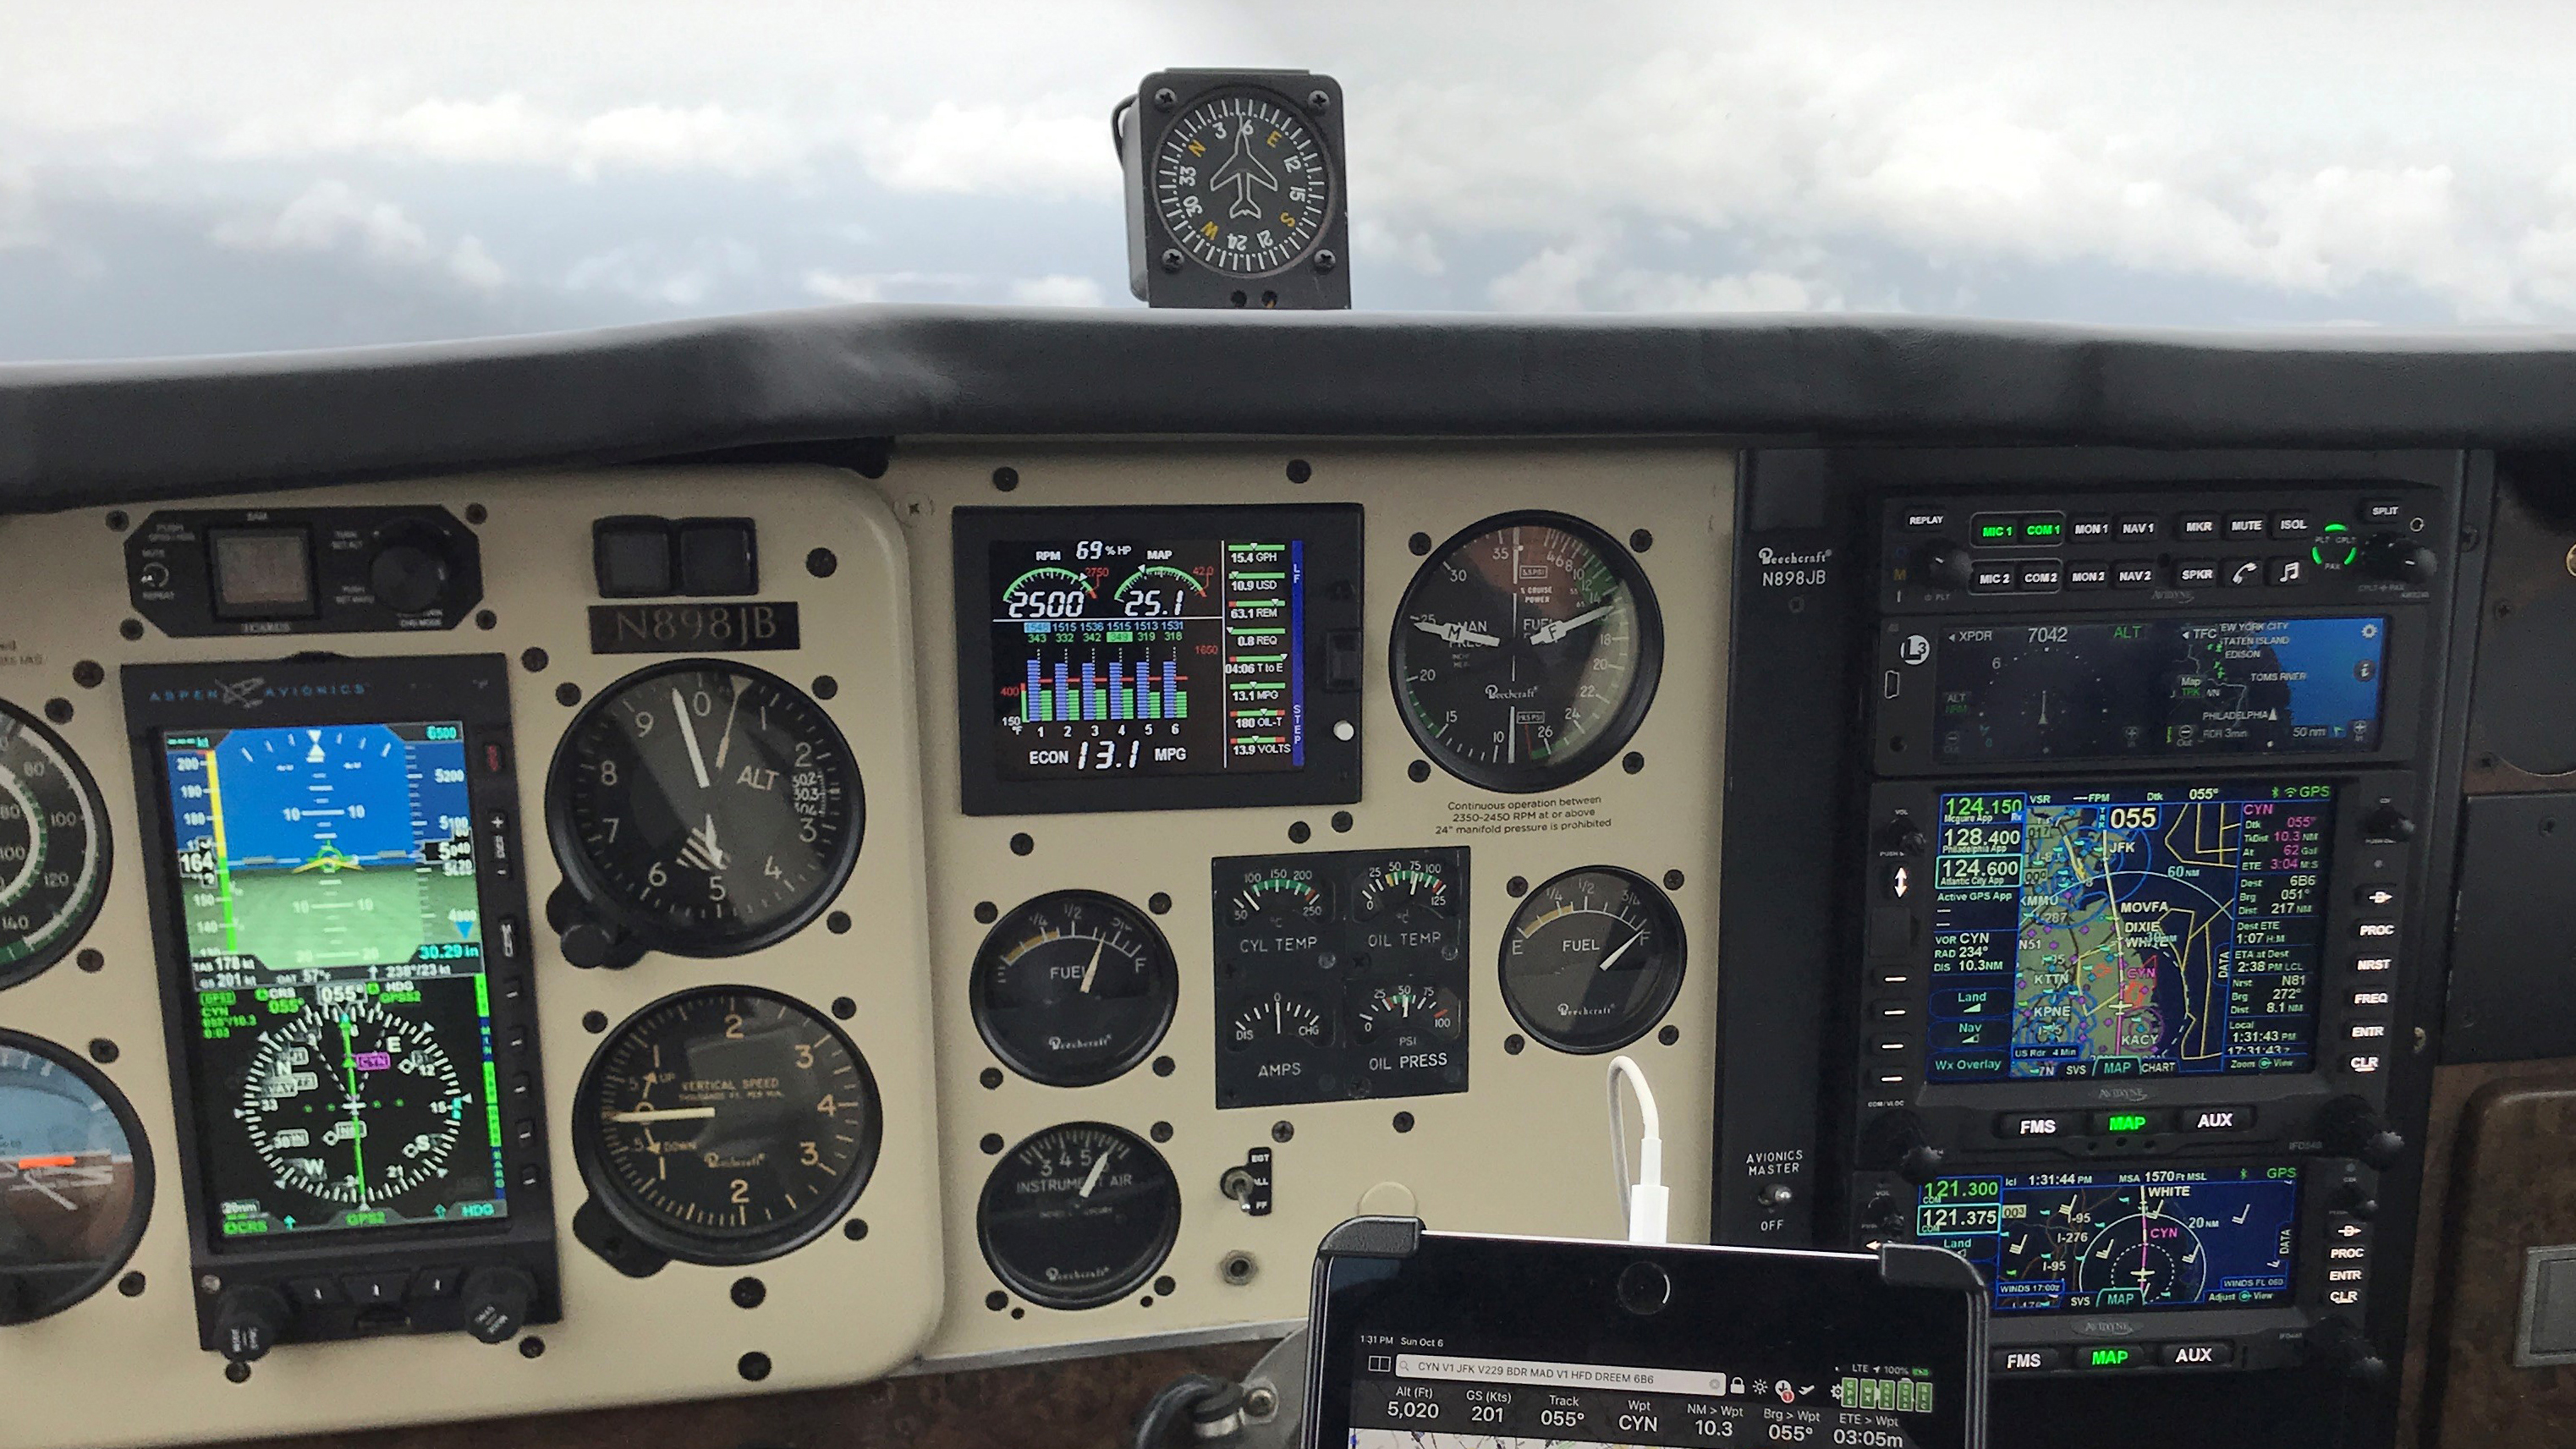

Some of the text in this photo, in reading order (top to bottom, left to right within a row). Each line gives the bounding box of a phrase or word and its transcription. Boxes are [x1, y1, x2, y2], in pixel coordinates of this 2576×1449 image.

[1211, 122, 1228, 140] 3
[1266, 130, 1283, 149] E
[1187, 139, 1207, 158] N
[1283, 155, 1302, 174] 12
[1178, 165, 1197, 187] 33
[1289, 185, 1306, 203] 15
[1279, 211, 1296, 228] S
[2372, 506, 2399, 516] SPLIT
[1909, 515, 1944, 525] REPLAY
[2186, 520, 2212, 533] MKR
[2231, 520, 2264, 531] MUTE
[2280, 519, 2307, 530] ISOL
[1981, 526, 2013, 537] MIC 1
[2026, 524, 2060, 535] COM 1
[2074, 524, 2108, 535] MON 1
[2123, 523, 2155, 534] NAV 1
[1035, 551, 1062, 561] RPM
[1146, 550, 1173, 560] MAP
[1230, 552, 1277, 563] 15.4 GPH
[1491, 546, 1510, 561] 35
[1757, 546, 1827, 565] Beechcraft
[1449, 568, 1468, 582] 30
[1761, 569, 1827, 587] N898JB
[2181, 568, 2213, 581] SPKR
[1231, 579, 1277, 591] 10.9 USD
[1008, 591, 1085, 618] 2500
[1124, 590, 1184, 617] 25.1
[1230, 607, 1277, 619] 63.1 REM
[615, 606, 777, 646] N898JB
[2193, 628, 2218, 639] TFC
[1237, 635, 1277, 646] 0.8 REQ
[1958, 625, 2143, 644] XPDR 7042 ALT
[2223, 650, 2261, 659] EDISON
[1419, 668, 1436, 682] 20
[1484, 683, 1535, 700] Beechcraft
[2202, 711, 2270, 721] PHILADELPHIA
[634, 711, 655, 739] 9
[1536, 725, 1554, 739] 26
[1029, 740, 1187, 771] ECON 13.1 MPG
[1233, 744, 1292, 755] 13.9 VOLTS
[599, 760, 618, 787] 8
[735, 765, 781, 792] ALT
[2299, 786, 2332, 798] GPS
[1447, 795, 1602, 811] Continuous operation between
[1945, 797, 2023, 816] 124.150
[1452, 809, 1596, 822] 2350-2450 RPM at or above
[2109, 807, 2157, 829] 055
[1455, 824, 1502, 835] manifold
[1503, 823, 1548, 835] pressure
[1550, 822, 1559, 832] is
[1560, 818, 1612, 832] prohibited
[1943, 827, 2021, 847] 128.400
[2109, 842, 2136, 853] JFK
[180, 853, 214, 874] 164
[1942, 859, 2019, 877] 124.600
[2288, 875, 2317, 886] 6B6
[707, 875, 727, 903] 5
[1936, 892, 2013, 903] Active GPS App
[2120, 901, 2169, 914] MOVFA
[2359, 924, 2396, 936] PROC
[1239, 935, 1318, 953] CYL TEMP
[1367, 931, 1442, 948] OIL TEMP
[1562, 938, 1601, 952] FUEL
[1935, 931, 1990, 945] VOR CYN
[2357, 959, 2392, 970] NRST
[1957, 991, 1988, 1003] Land
[2354, 993, 2389, 1005] FREQ
[2033, 1006, 2071, 1017] KPNE
[724, 1013, 745, 1040] 2
[2351, 1026, 2385, 1038] ENTR
[1368, 1051, 1449, 1072] OIL PRESS
[1935, 1058, 2002, 1072] Wx Overlay
[2103, 1062, 2132, 1074] MAP
[2350, 1057, 2379, 1069] CLR
[1257, 1062, 1303, 1078] AMPS
[679, 1076, 781, 1092] VERTICAL SPEED
[816, 1093, 838, 1118] 4
[2019, 1118, 2057, 1134] FMS
[2108, 1114, 2148, 1131] MAP
[2196, 1111, 2235, 1128] AUX
[1745, 1149, 1804, 1164] AVIONICS
[1748, 1161, 1800, 1177] MASTER
[2266, 1167, 2298, 1178] GPS
[1109, 1173, 1134, 1188] AIR
[1924, 1180, 1999, 1199] 121.300
[2147, 1185, 2192, 1198] WHITE
[1760, 1219, 1784, 1232] OFF
[1922, 1209, 1998, 1227] 121.375
[1943, 1238, 1972, 1249] Land
[2330, 1248, 2365, 1259] PROC
[2329, 1270, 2363, 1282] ENTR
[2330, 1290, 2359, 1303] CLR
[1400, 1336, 1444, 1347] Sun Oct 6
[2006, 1352, 2042, 1370] FMS
[2091, 1348, 2129, 1366] MAP
[2174, 1347, 2213, 1364] AUX
[1418, 1361, 1655, 1385] CYN V1 JFK V229 BDR MAD V1 HFD DREEM 6B6
[1396, 1385, 1434, 1399] Alt (Ft)
[1465, 1390, 1513, 1405] GS (Kts)
[1549, 1394, 1579, 1408] Track
[1628, 1399, 1652, 1413] Wpt
[1387, 1400, 1440, 1419] 5,020
[1470, 1405, 1504, 1424] 201
[1540, 1409, 1586, 1428] 055°
[1618, 1413, 1658, 1432] CYN
[1694, 1419, 1734, 1438] 10.3
[1832, 1428, 1905, 1449] 03:05m
